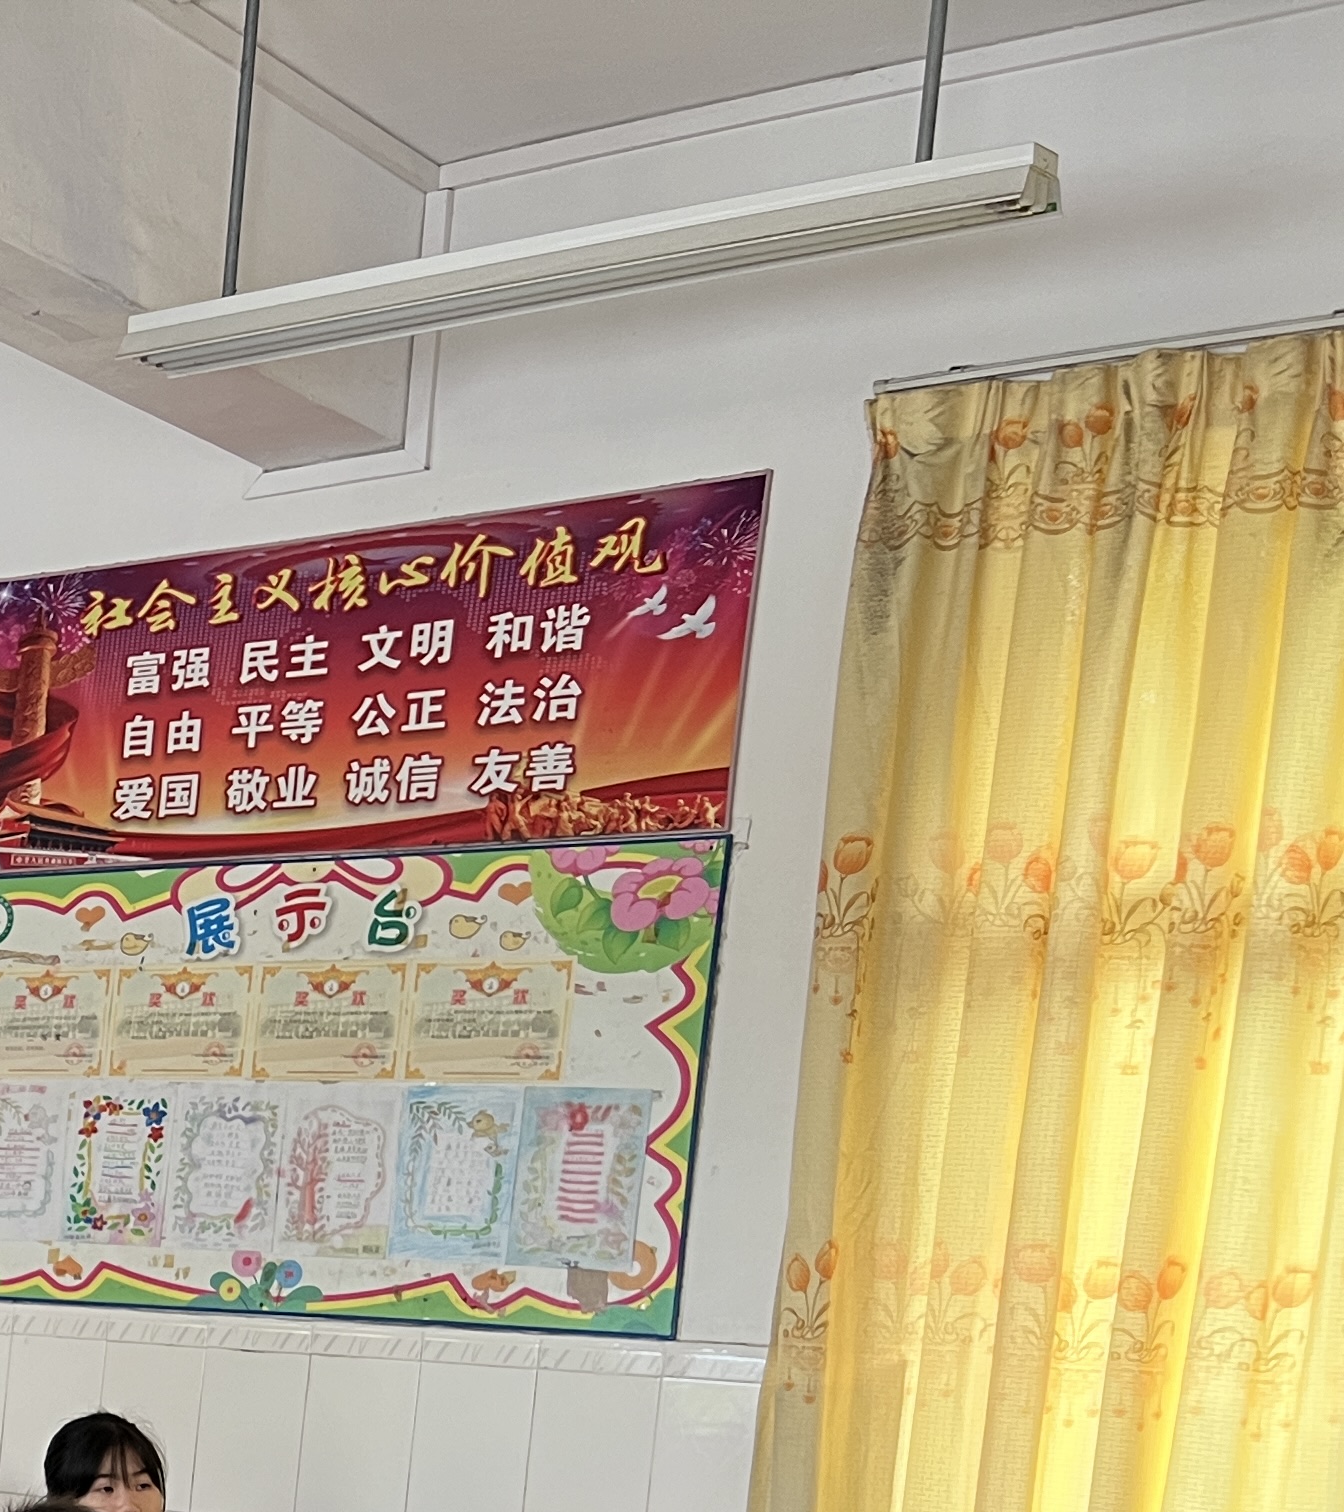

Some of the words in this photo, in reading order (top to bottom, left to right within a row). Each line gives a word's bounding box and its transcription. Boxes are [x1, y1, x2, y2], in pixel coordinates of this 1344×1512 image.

[80, 516, 666, 638] 社会主义核心价值观
[126, 646, 210, 697] 富强
[238, 634, 330, 684] 民主
[357, 621, 454, 673] 文明
[486, 604, 592, 661] 和谐
[122, 708, 203, 760] 自由
[231, 697, 325, 750] 平等
[352, 687, 447, 739] 公正
[478, 675, 583, 728] 法治
[113, 773, 199, 821] 爱国
[226, 764, 316, 813] 敬业
[346, 754, 443, 806] 诚信
[471, 744, 575, 796] 友善
[185, 887, 418, 956] 展示台
